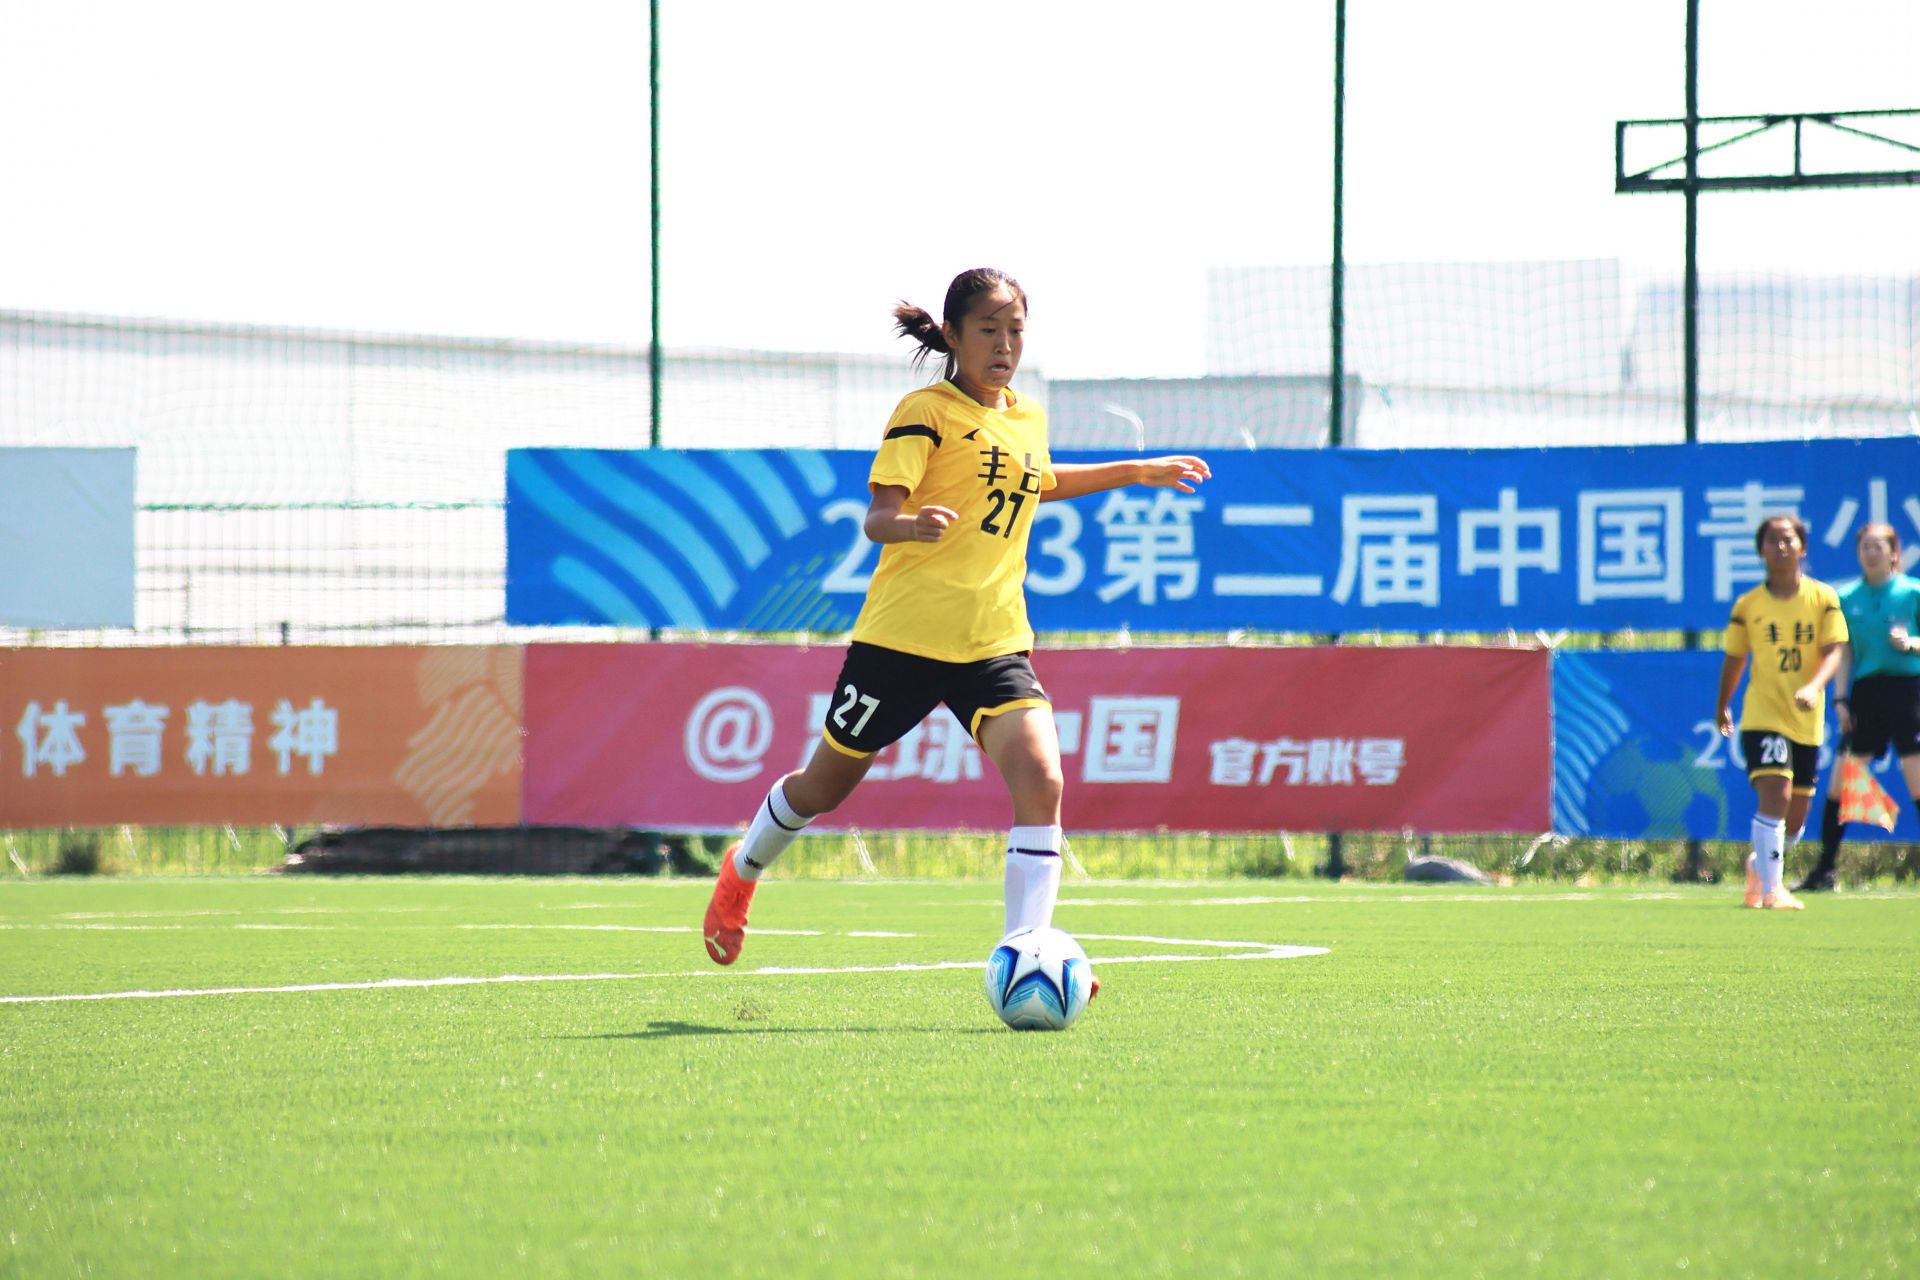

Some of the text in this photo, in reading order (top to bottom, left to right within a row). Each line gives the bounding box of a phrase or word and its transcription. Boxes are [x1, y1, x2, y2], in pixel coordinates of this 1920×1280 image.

[980, 489, 1025, 539] 27
[821, 477, 1920, 607] 23第二届中国青少
[1779, 648, 1802, 672] 20
[833, 684, 880, 738] 27
[17, 699, 338, 778] 体育精神
[1209, 737, 1406, 786] 官方账号
[1760, 736, 1788, 764] 20
